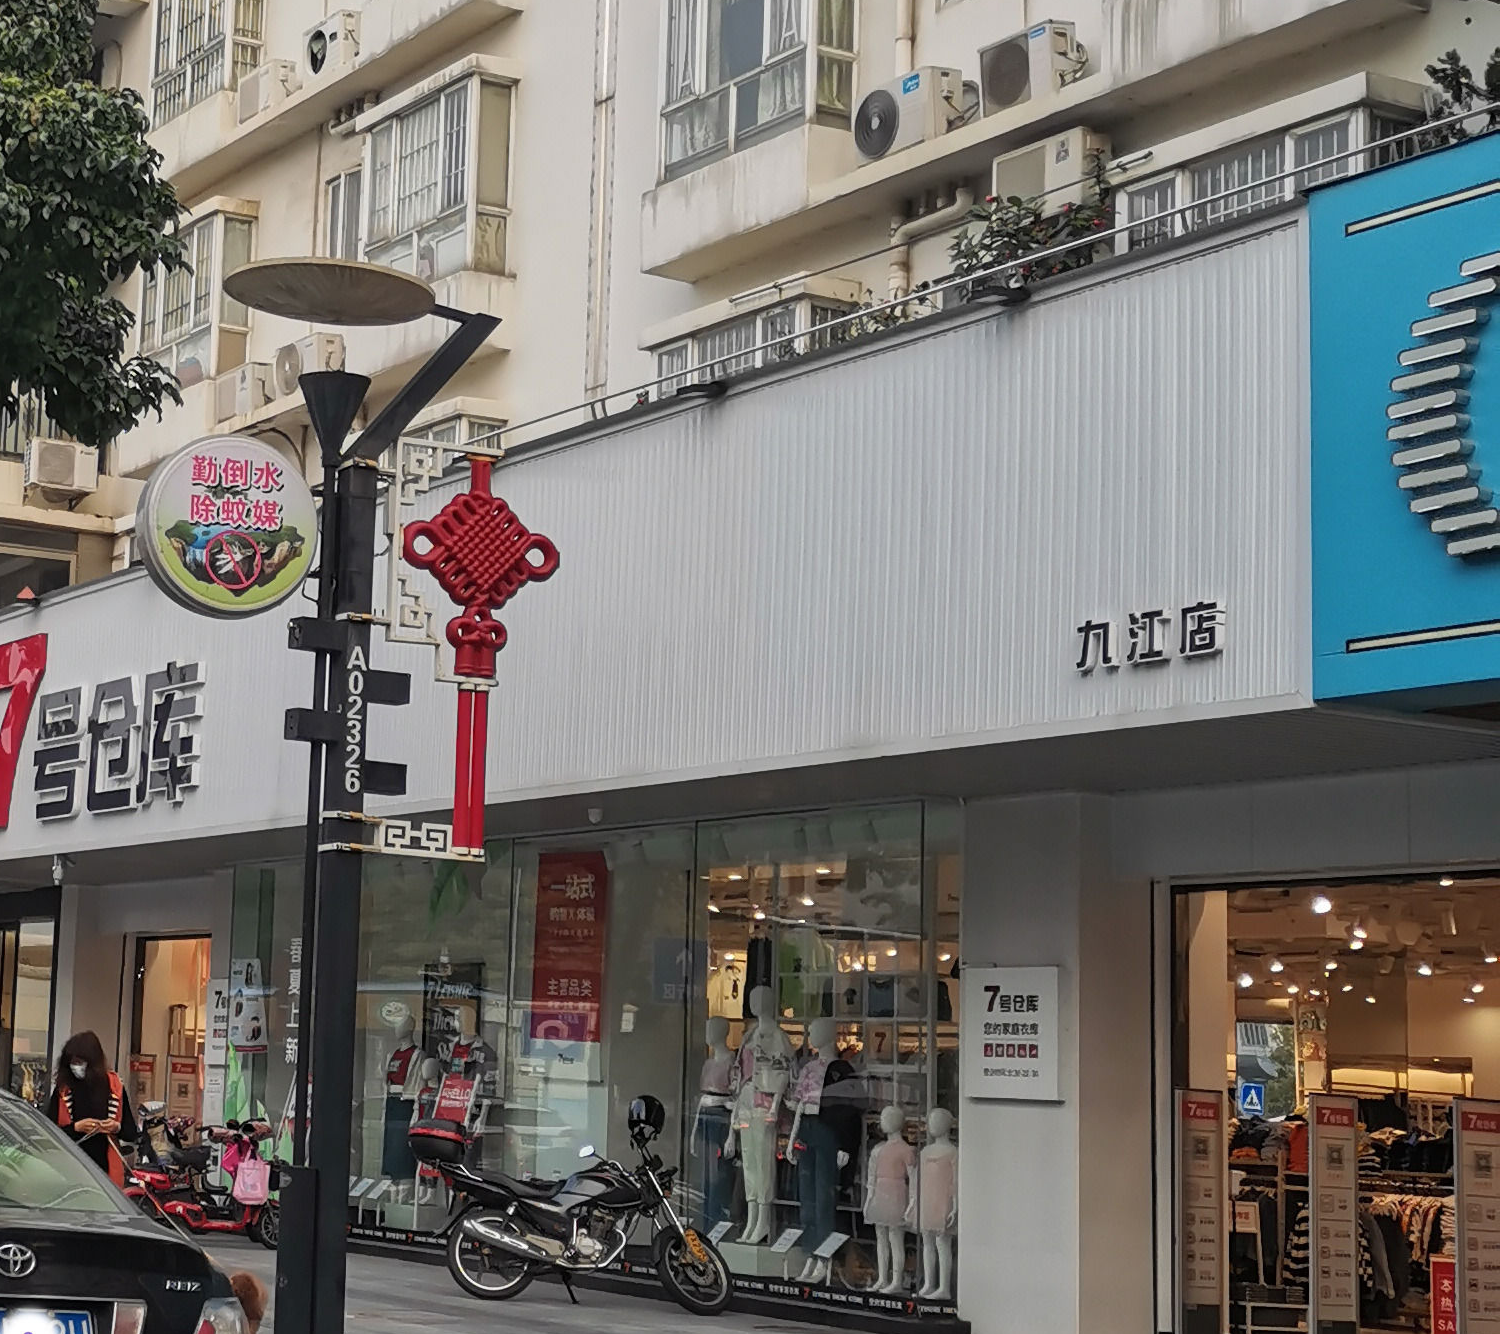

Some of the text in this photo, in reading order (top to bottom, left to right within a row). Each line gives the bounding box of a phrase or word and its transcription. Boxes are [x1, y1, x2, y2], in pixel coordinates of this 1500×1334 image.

[191, 454, 281, 489] 勤倒水
[190, 494, 280, 528] 除蚊媒
[1076, 601, 1222, 670] 九江店
[345, 645, 368, 794] A02326
[984, 986, 1039, 1013] 7号仓库
